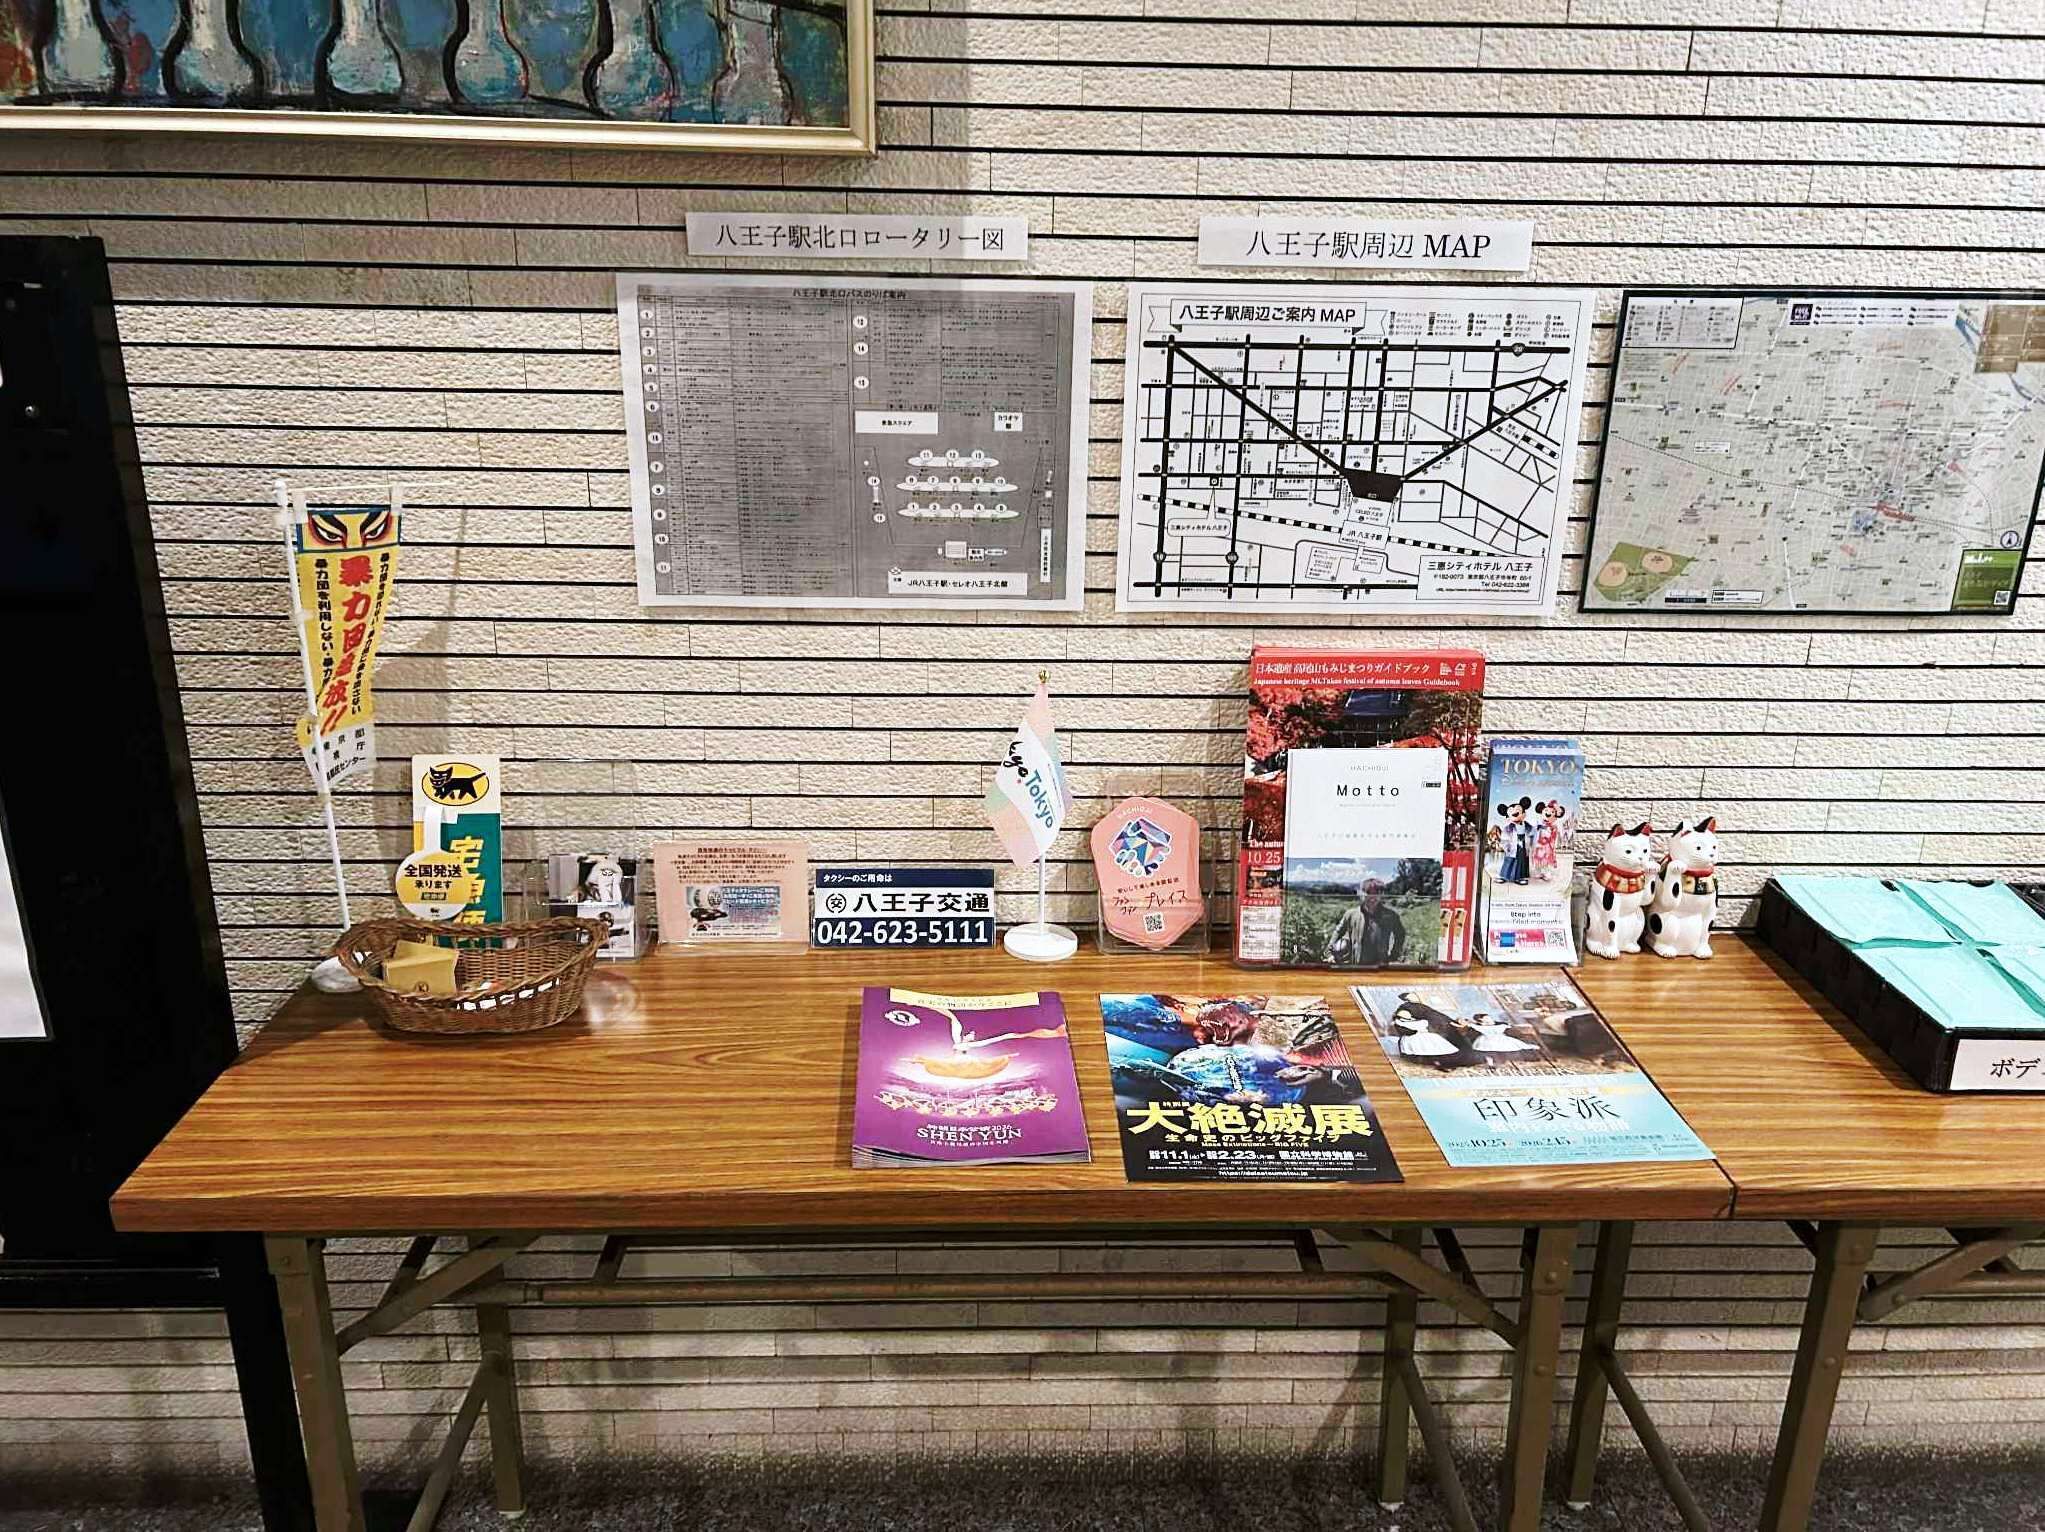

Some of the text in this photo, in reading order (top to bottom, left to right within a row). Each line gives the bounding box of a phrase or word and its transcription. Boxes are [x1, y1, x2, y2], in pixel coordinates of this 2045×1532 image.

[716, 226, 1004, 251] 八王子駅北口ロータリー図
[1246, 230, 1491, 258] 八王子駅周辺 MAP
[1179, 305, 1356, 322] 八王子駅周辺ご案内 MAP
[1504, 562, 1534, 572] 八王子
[1254, 678, 1283, 686] Japanese
[1423, 678, 1460, 686] Guidebook
[1501, 758, 1577, 775] TOKYO
[1025, 769, 1053, 828] Tokyo
[1336, 784, 1400, 797] Motto
[1249, 839, 1263, 848] The
[1248, 850, 1281, 864] 10.25
[404, 864, 462, 878] 全国発送
[823, 873, 893, 883] タクシーのご用命は
[415, 879, 452, 889] 承ります
[853, 893, 990, 913] 八王子交通
[817, 921, 988, 944] 042-623-5111
[1990, 1058, 2045, 1079] ボデ
[1473, 1095, 1621, 1123] 印象派
[1127, 1102, 1374, 1137] 大絶滅展
[917, 1127, 973, 1142] SHEN
[978, 1128, 1022, 1141] YUN
